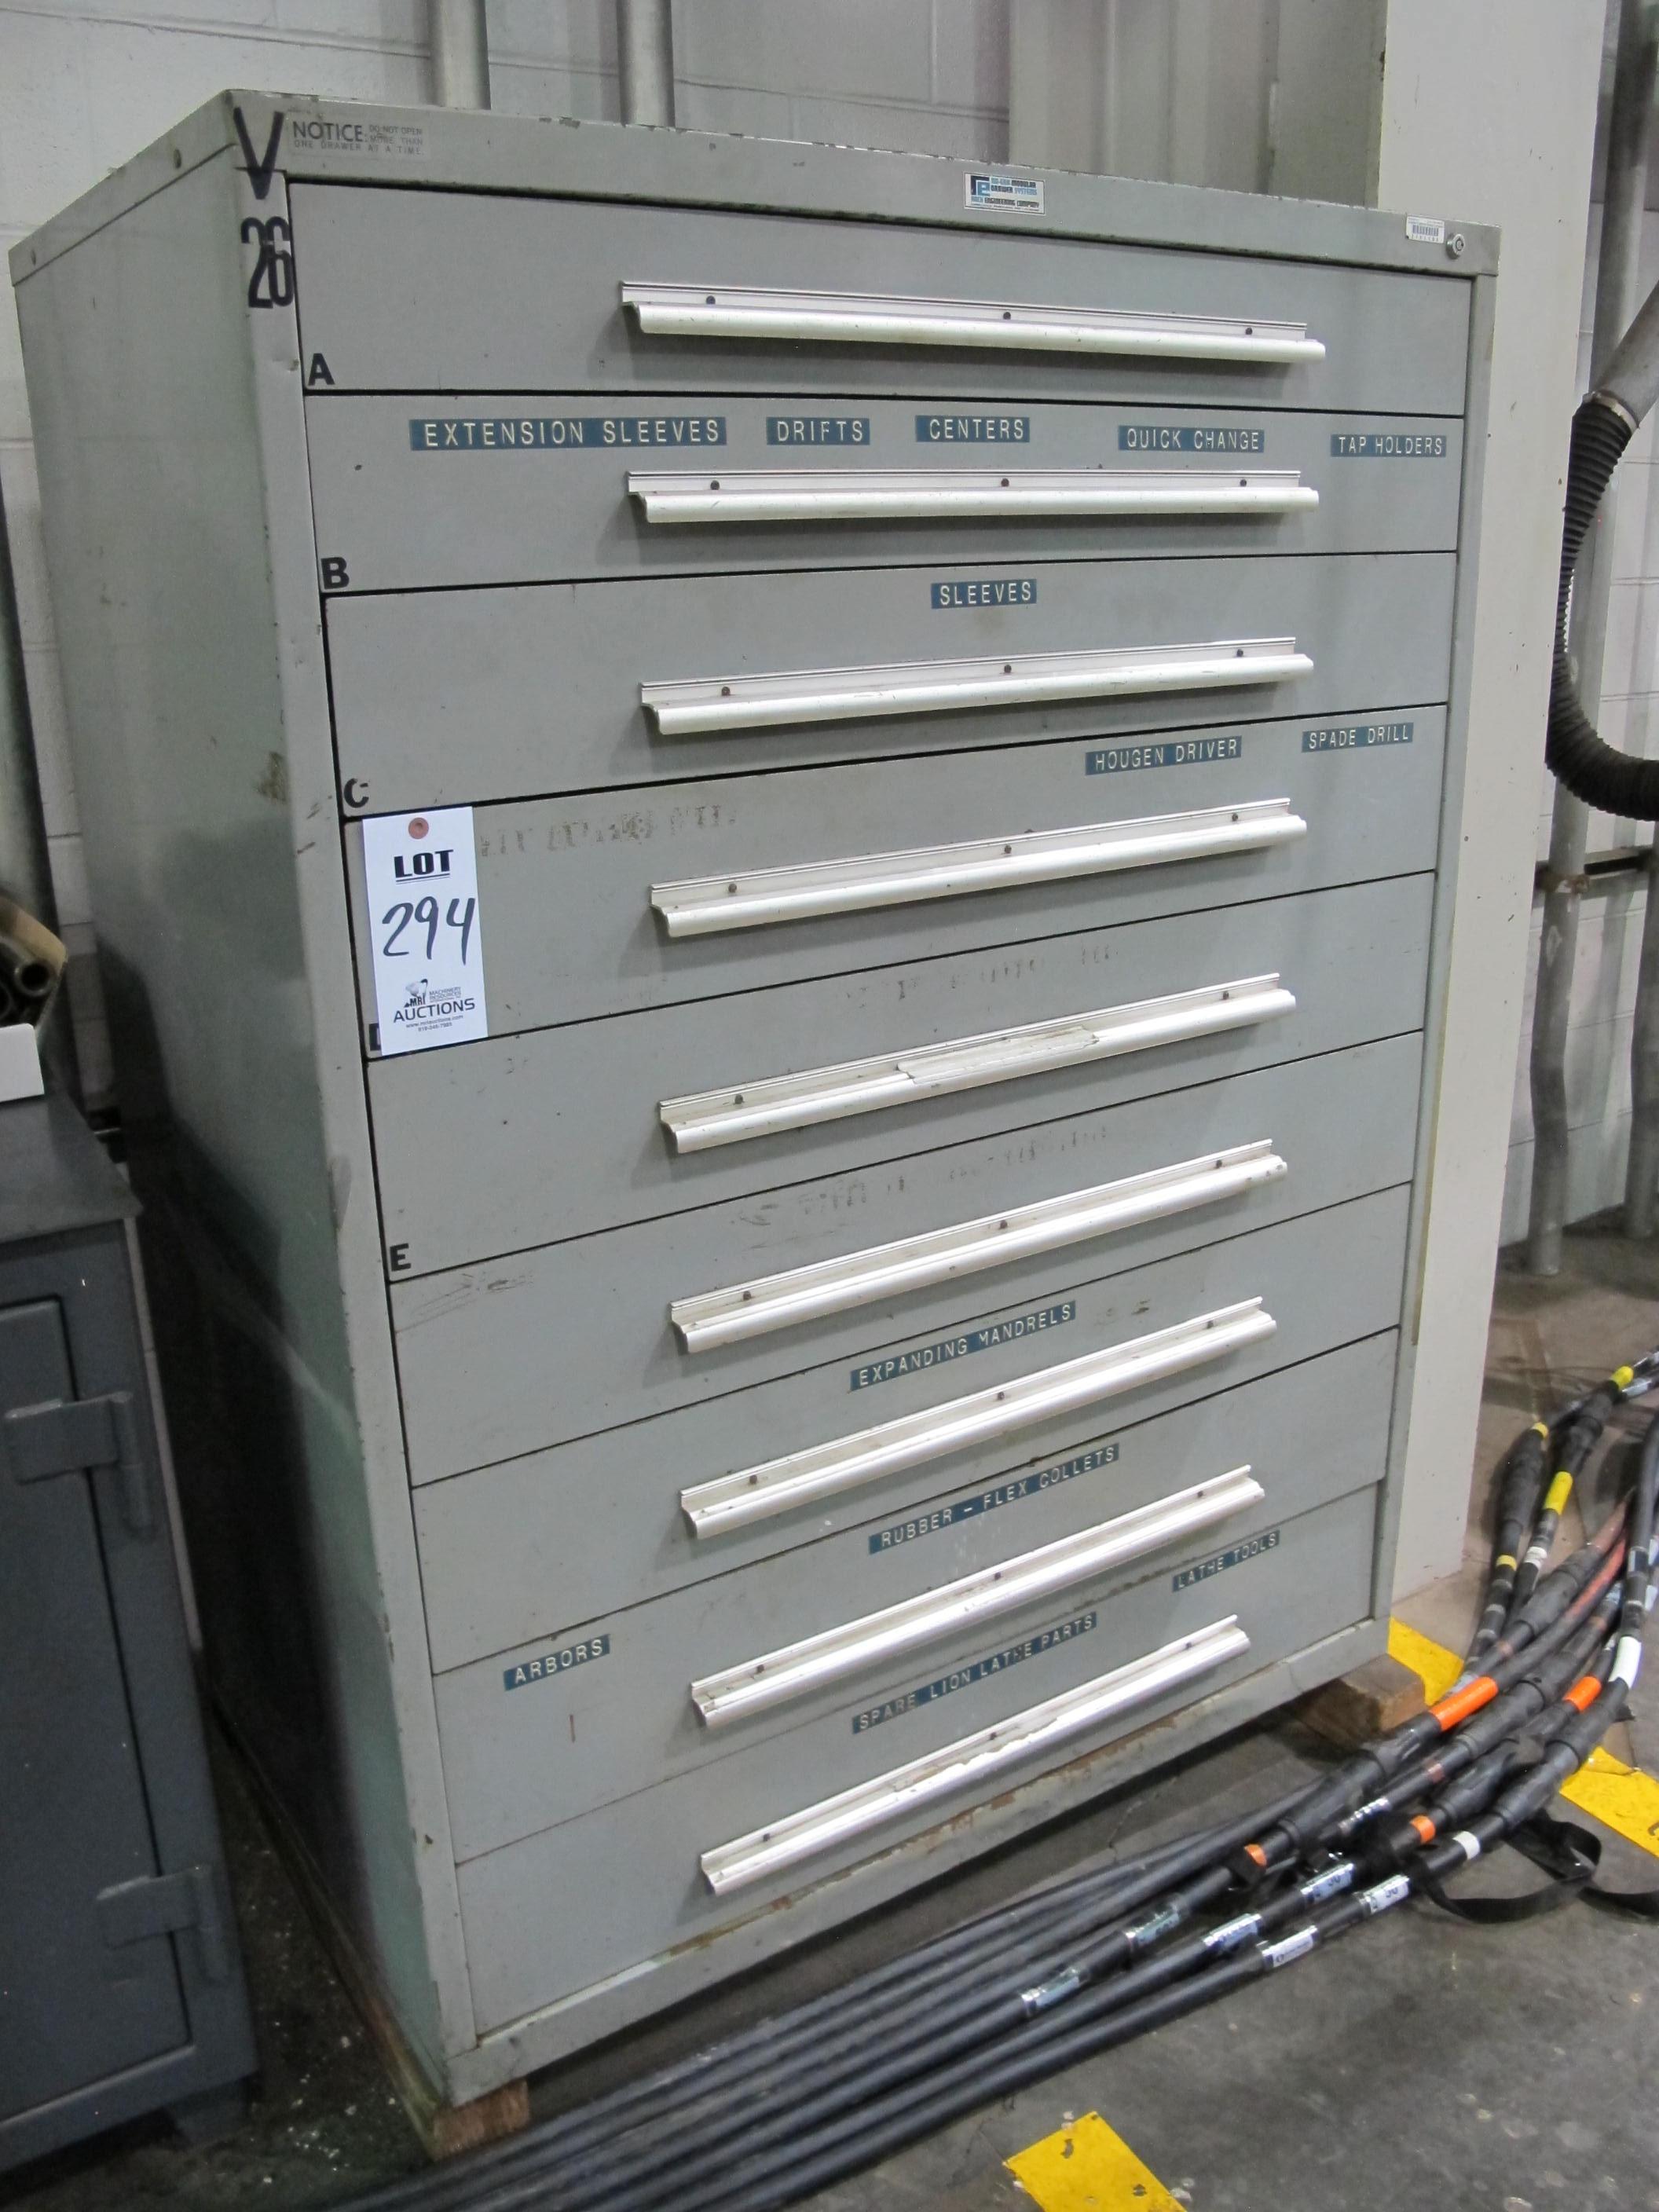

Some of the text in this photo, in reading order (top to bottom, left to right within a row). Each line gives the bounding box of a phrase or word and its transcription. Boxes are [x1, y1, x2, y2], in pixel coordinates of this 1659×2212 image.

[383, 125, 398, 134] NOT
[401, 126, 423, 136] OPEN
[234, 106, 284, 200] V
[295, 139, 313, 149] ONE
[320, 141, 361, 152] DRAWER
[308, 353, 335, 386] A
[424, 419, 719, 447] EXTENSION SLEEVES
[777, 420, 863, 442] DRIFTS
[929, 419, 1024, 441] CENTERS
[1126, 428, 1259, 450] QUICK CHANGE
[1339, 435, 1443, 455] TAP HOLDERS
[320, 557, 350, 590] B
[939, 581, 1031, 606] SLEEVES
[1309, 725, 1408, 749] SPADE DRILL
[1095, 738, 1237, 771] HOUGEN DRIVER
[343, 778, 369, 808] C
[394, 849, 454, 878] LOT
[382, 895, 476, 965] 294
[393, 998, 475, 1023] AUCTIONS
[390, 1243, 412, 1272] E
[859, 1304, 1071, 1386] EXPANDING MANDRELS
[881, 1508, 952, 1548] RUBBER
[983, 1482, 1027, 1510] FLEX
[1039, 1447, 1115, 1489] COLLETS
[1178, 1533, 1276, 1588] LATHE TOOLS
[515, 1639, 603, 1683] ARBORS
[859, 1614, 1093, 1730] SPARE LION LATHE PARTS
